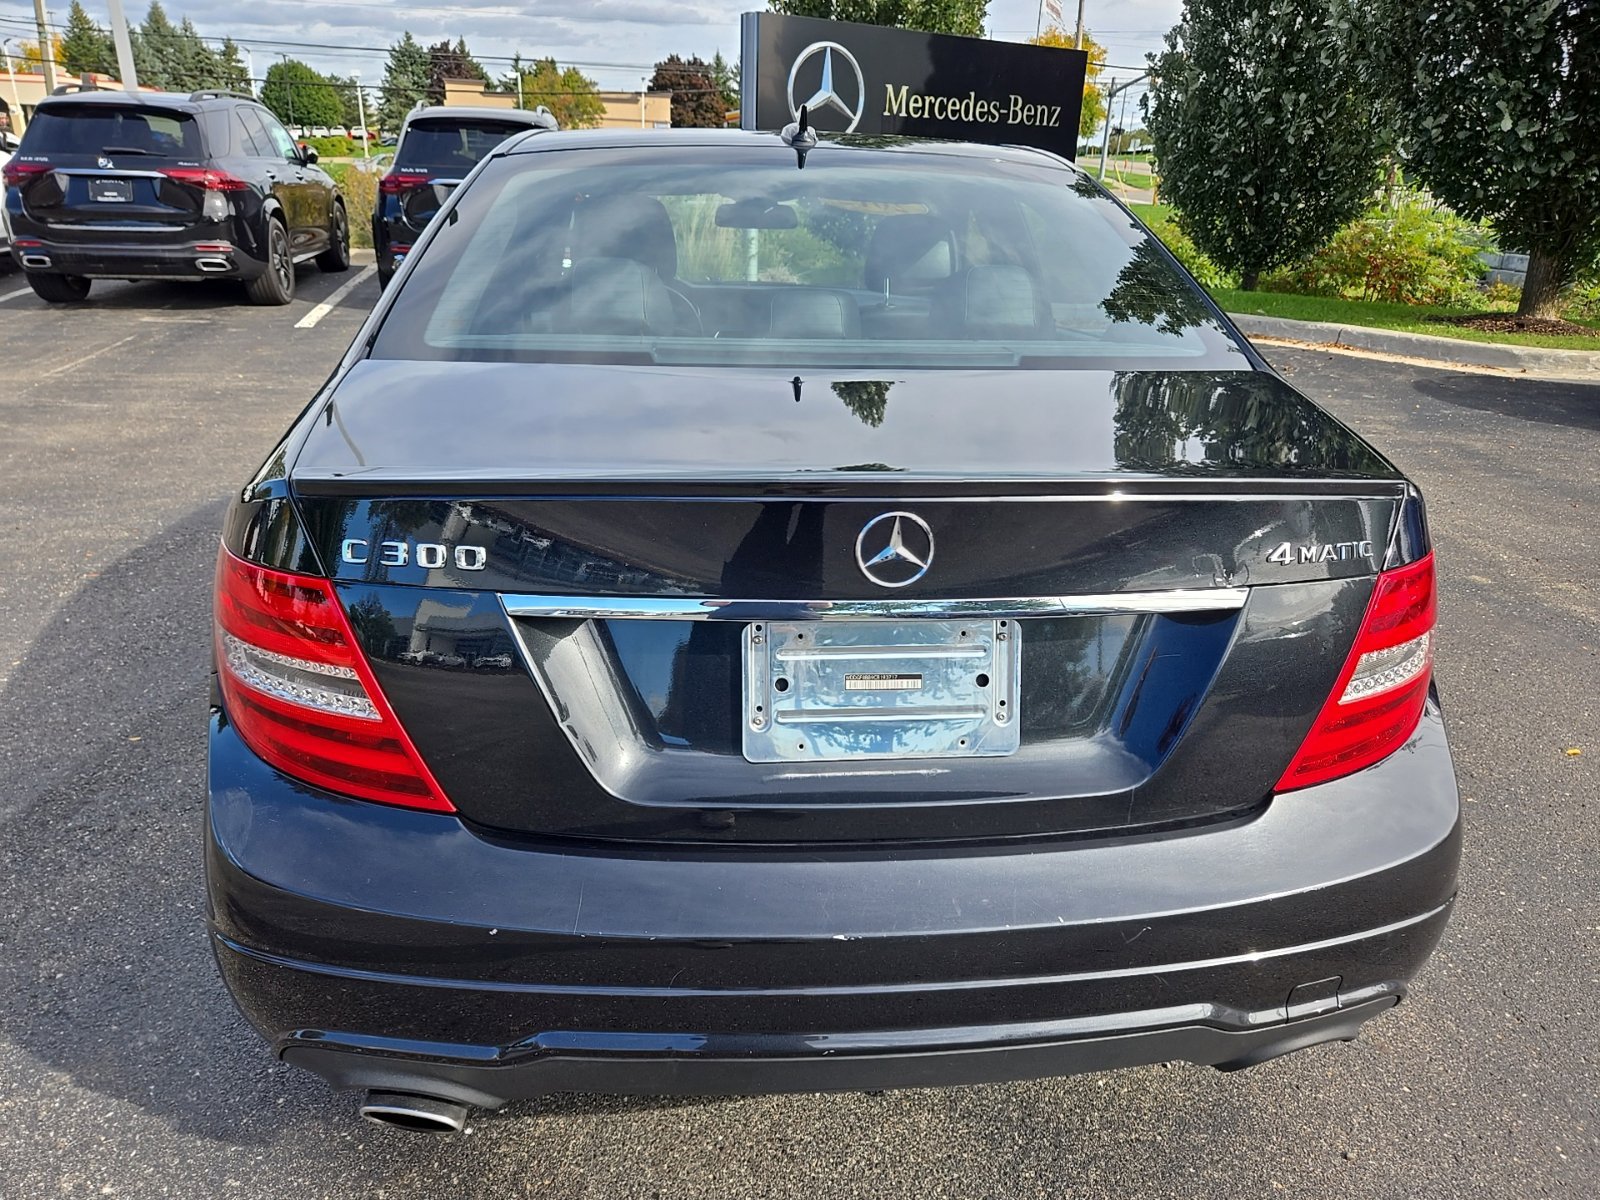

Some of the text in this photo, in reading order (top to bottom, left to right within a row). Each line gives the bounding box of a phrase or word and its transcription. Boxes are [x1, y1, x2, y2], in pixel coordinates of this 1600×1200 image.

[883, 83, 1062, 127] Mercedes-Benz
[341, 538, 487, 571] C 300
